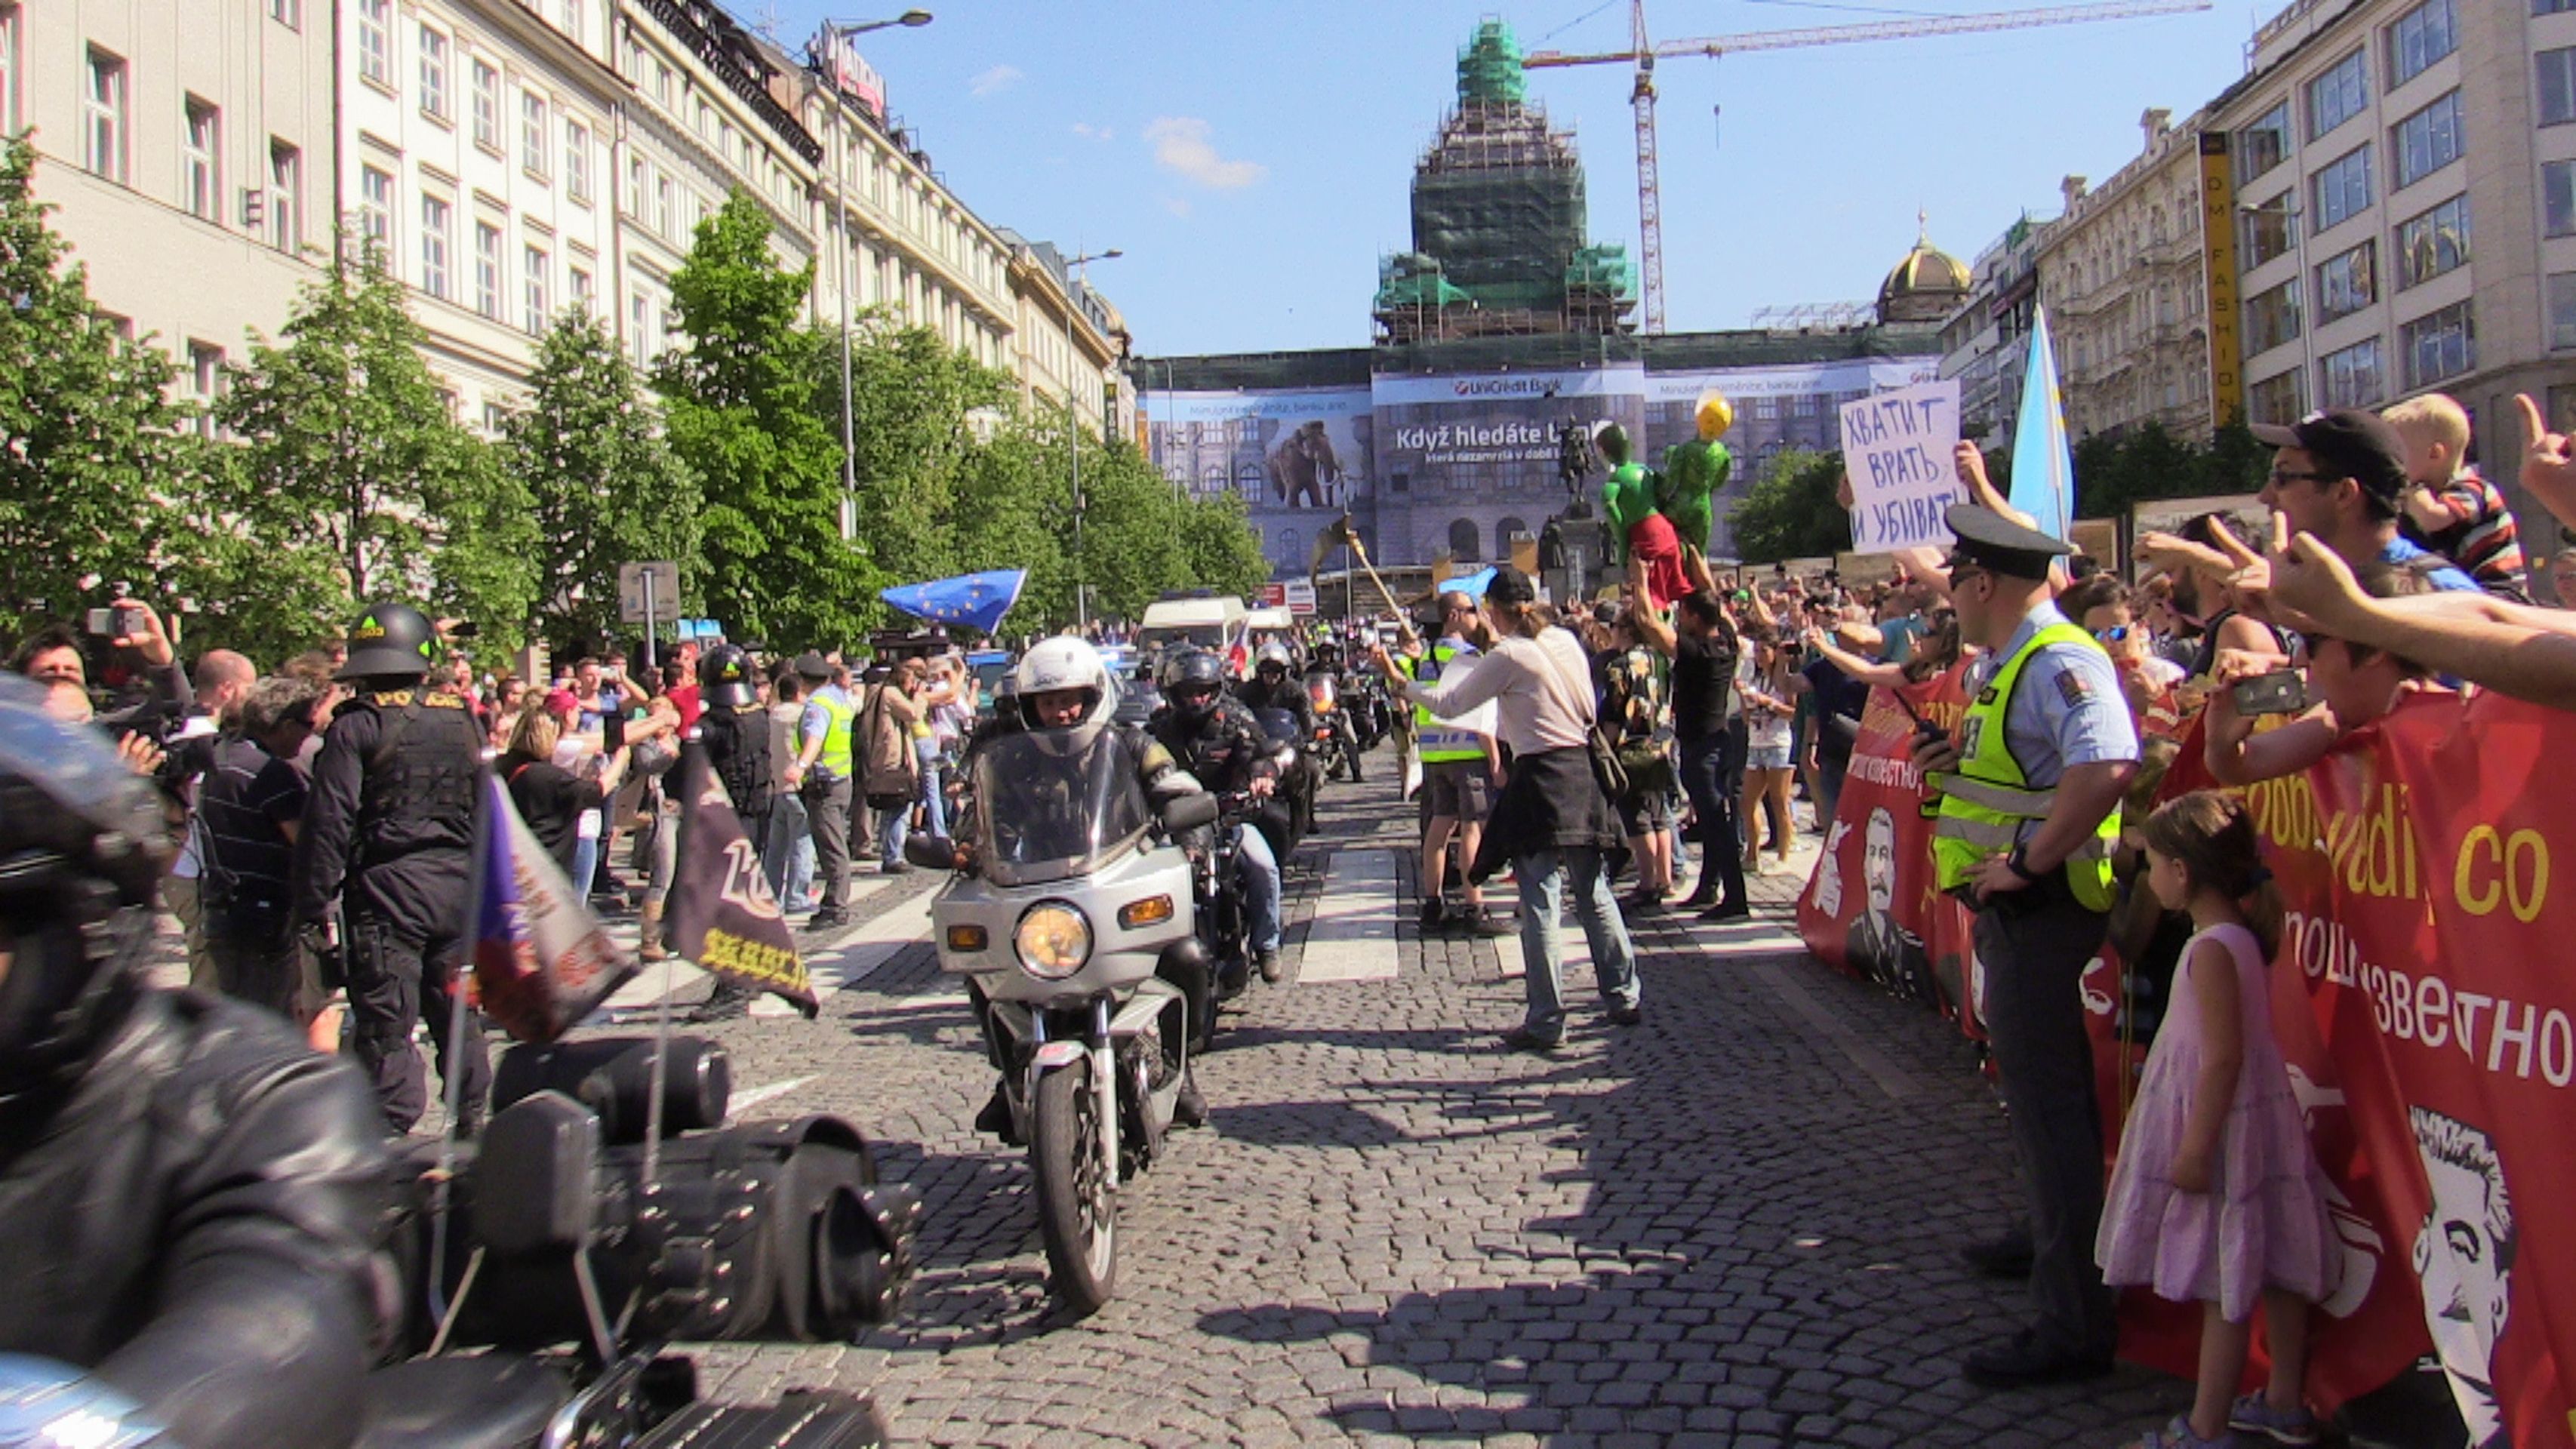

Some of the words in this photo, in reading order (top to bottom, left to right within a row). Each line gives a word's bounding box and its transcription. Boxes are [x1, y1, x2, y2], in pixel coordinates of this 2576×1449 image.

[1470, 380, 1527, 395] UniCredit
[1396, 425, 1450, 451] Když
[1455, 421, 1541, 447] hledáte
[1843, 397, 1946, 449] ХВАТИТ
[1851, 508, 1867, 544] И
